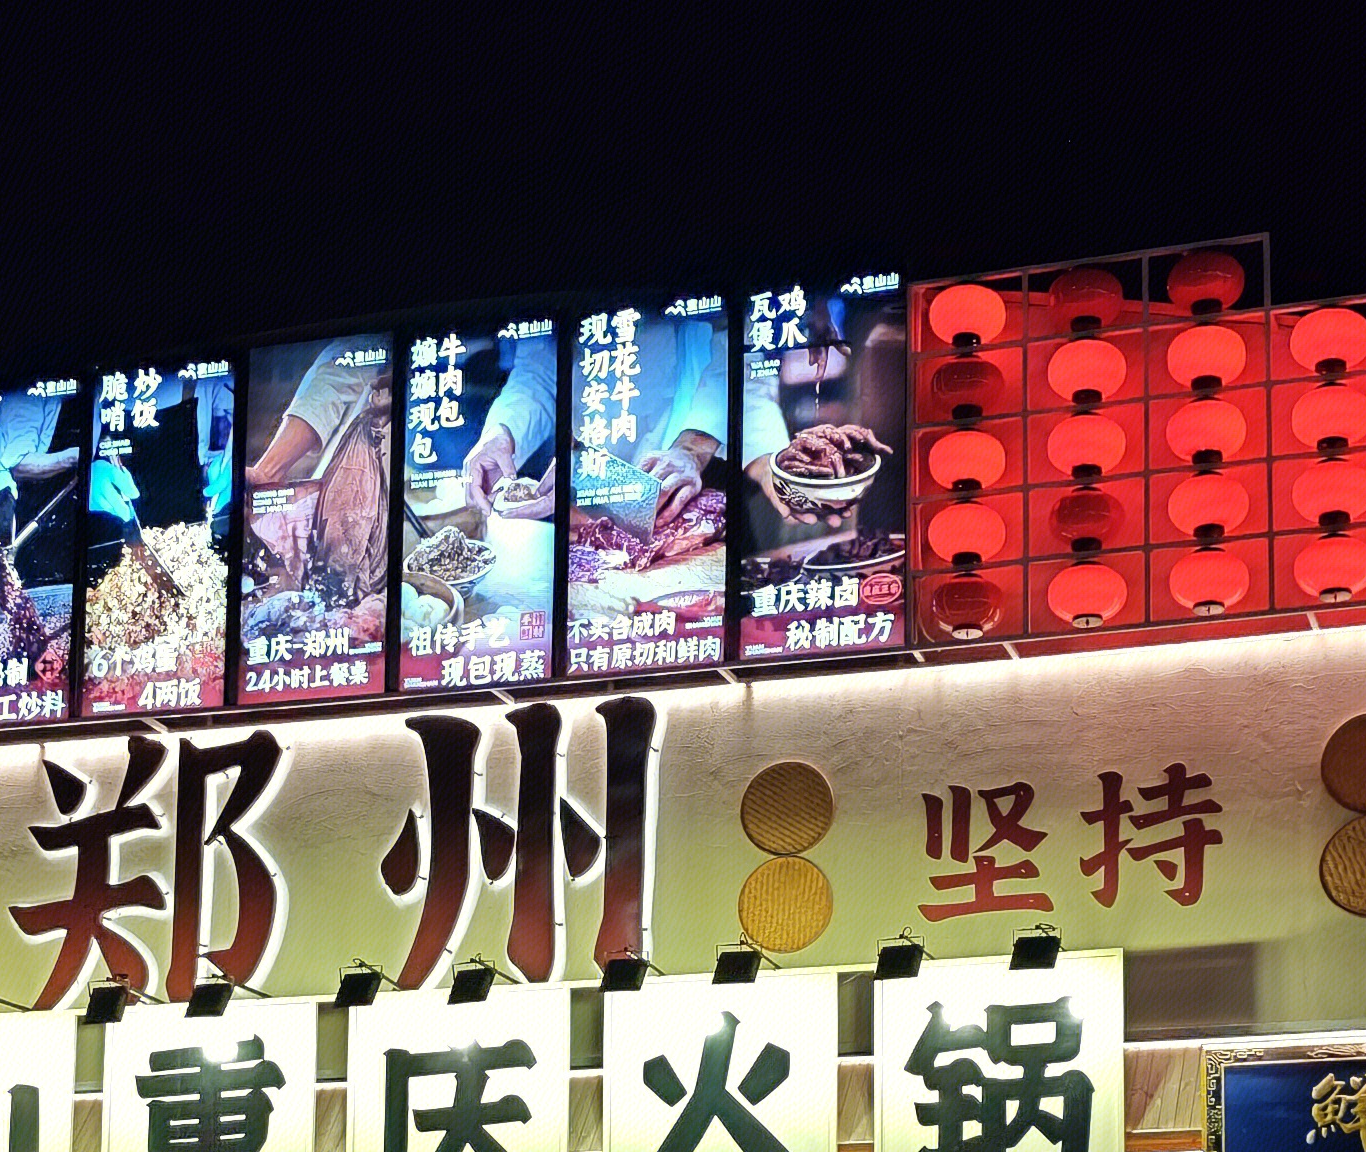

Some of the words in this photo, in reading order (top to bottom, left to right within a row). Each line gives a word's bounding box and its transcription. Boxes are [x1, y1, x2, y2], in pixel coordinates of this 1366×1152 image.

[751, 576, 859, 617] 重庆辣卤
[409, 617, 511, 656] 祖传手艺
[785, 612, 895, 651] 秘制配方
[441, 650, 545, 687] 现包现蒸
[567, 636, 721, 676] 只有原切和鲜肉
[138, 677, 202, 709] 4两饭
[13, 696, 657, 1010] 郑州
[917, 761, 1224, 922] 坚持
